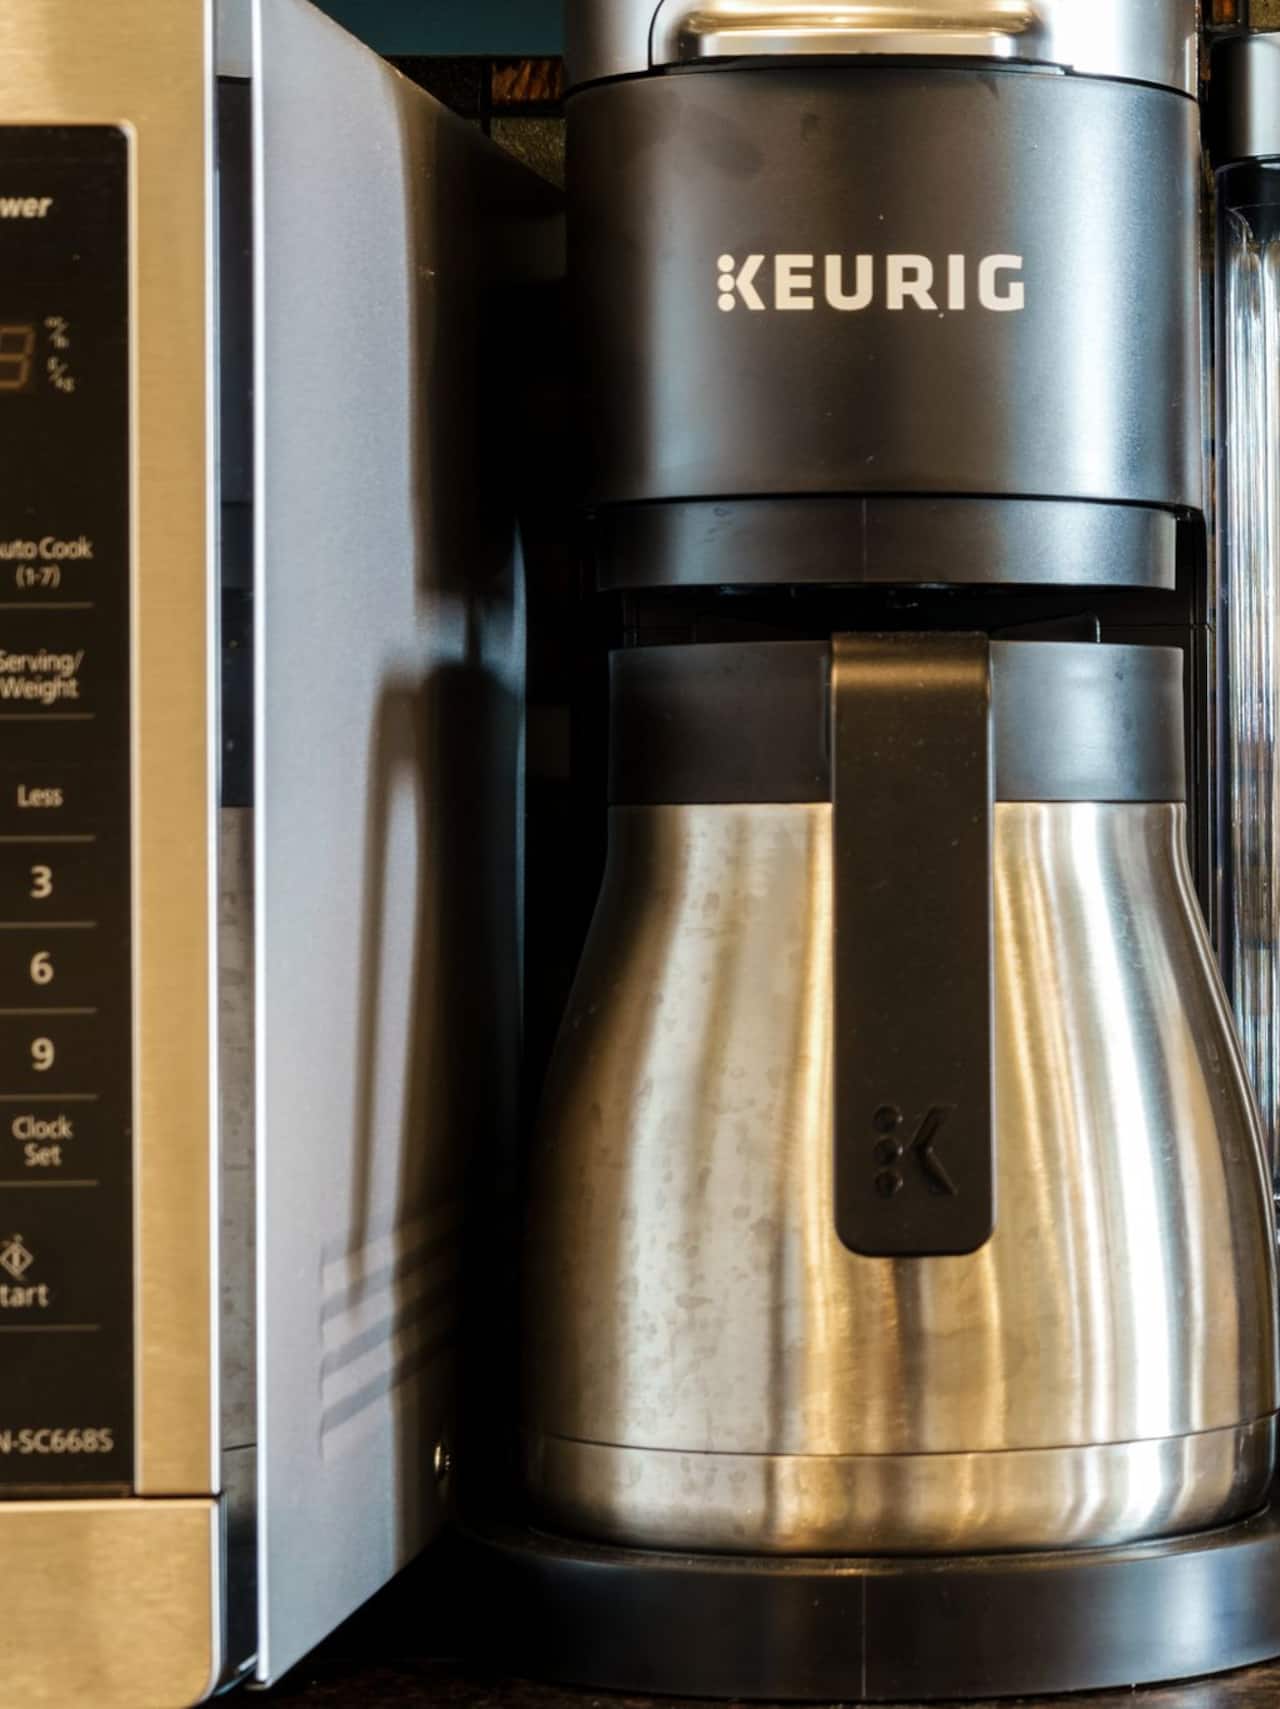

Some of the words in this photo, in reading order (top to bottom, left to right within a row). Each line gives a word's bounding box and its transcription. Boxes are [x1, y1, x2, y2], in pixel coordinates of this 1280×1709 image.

[717, 253, 1026, 312] KEURIG
[39, 535, 93, 560] Cook
[15, 564, 61, 588] (1-7)
[0, 676, 80, 704] Weight
[17, 784, 63, 808] Less
[30, 865, 53, 899] 3
[30, 952, 54, 985] 6
[31, 1037, 55, 1071] 9
[12, 1114, 73, 1140] Clock
[24, 1142, 62, 1167] Set
